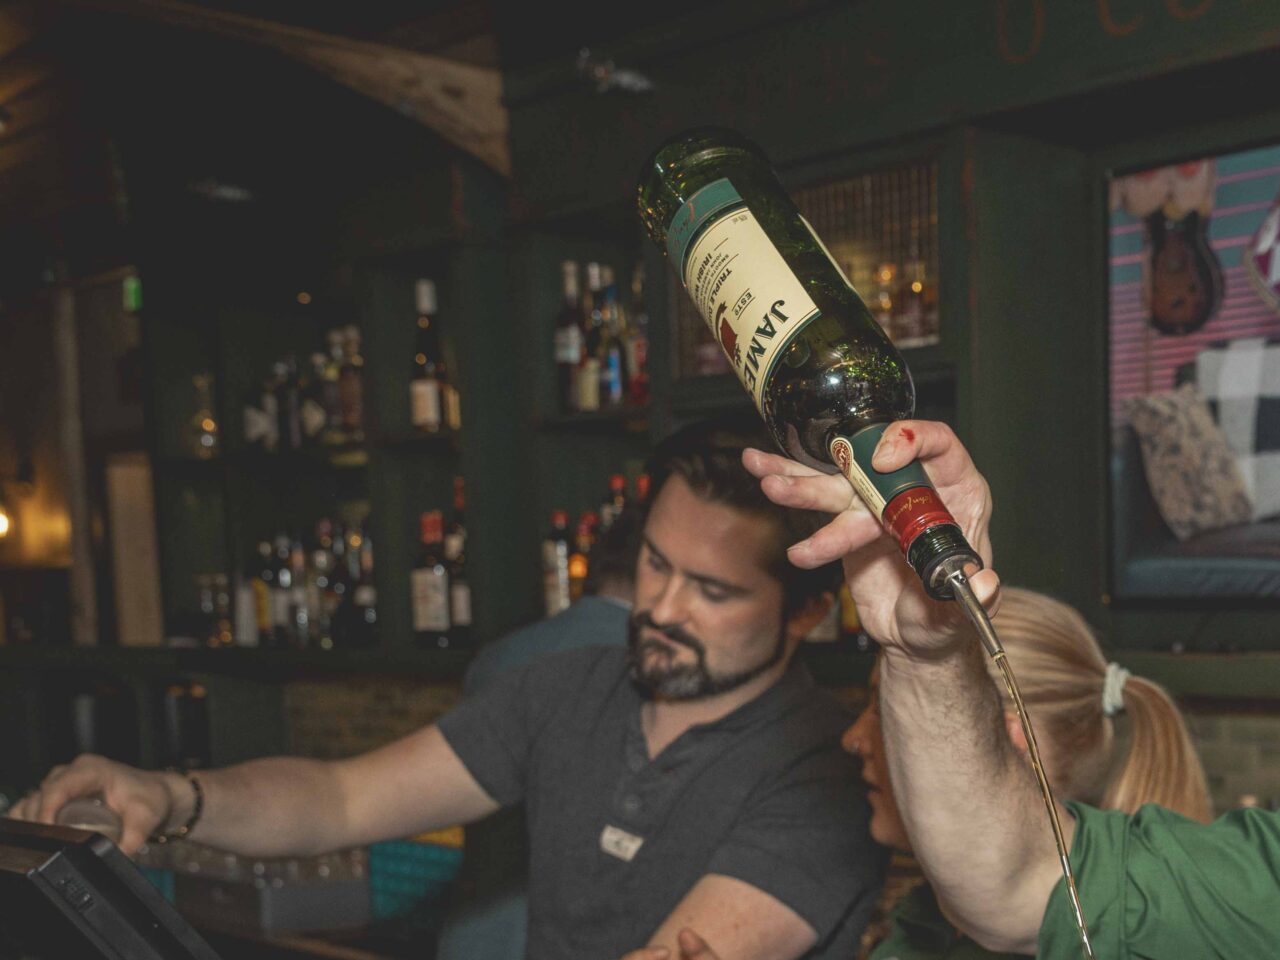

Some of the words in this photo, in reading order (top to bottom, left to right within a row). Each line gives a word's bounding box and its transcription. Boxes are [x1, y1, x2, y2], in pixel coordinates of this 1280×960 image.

[696, 252, 713, 283] IRISH
[710, 254, 729, 277] SMOOTH
[709, 267, 732, 305] TRIPLE
